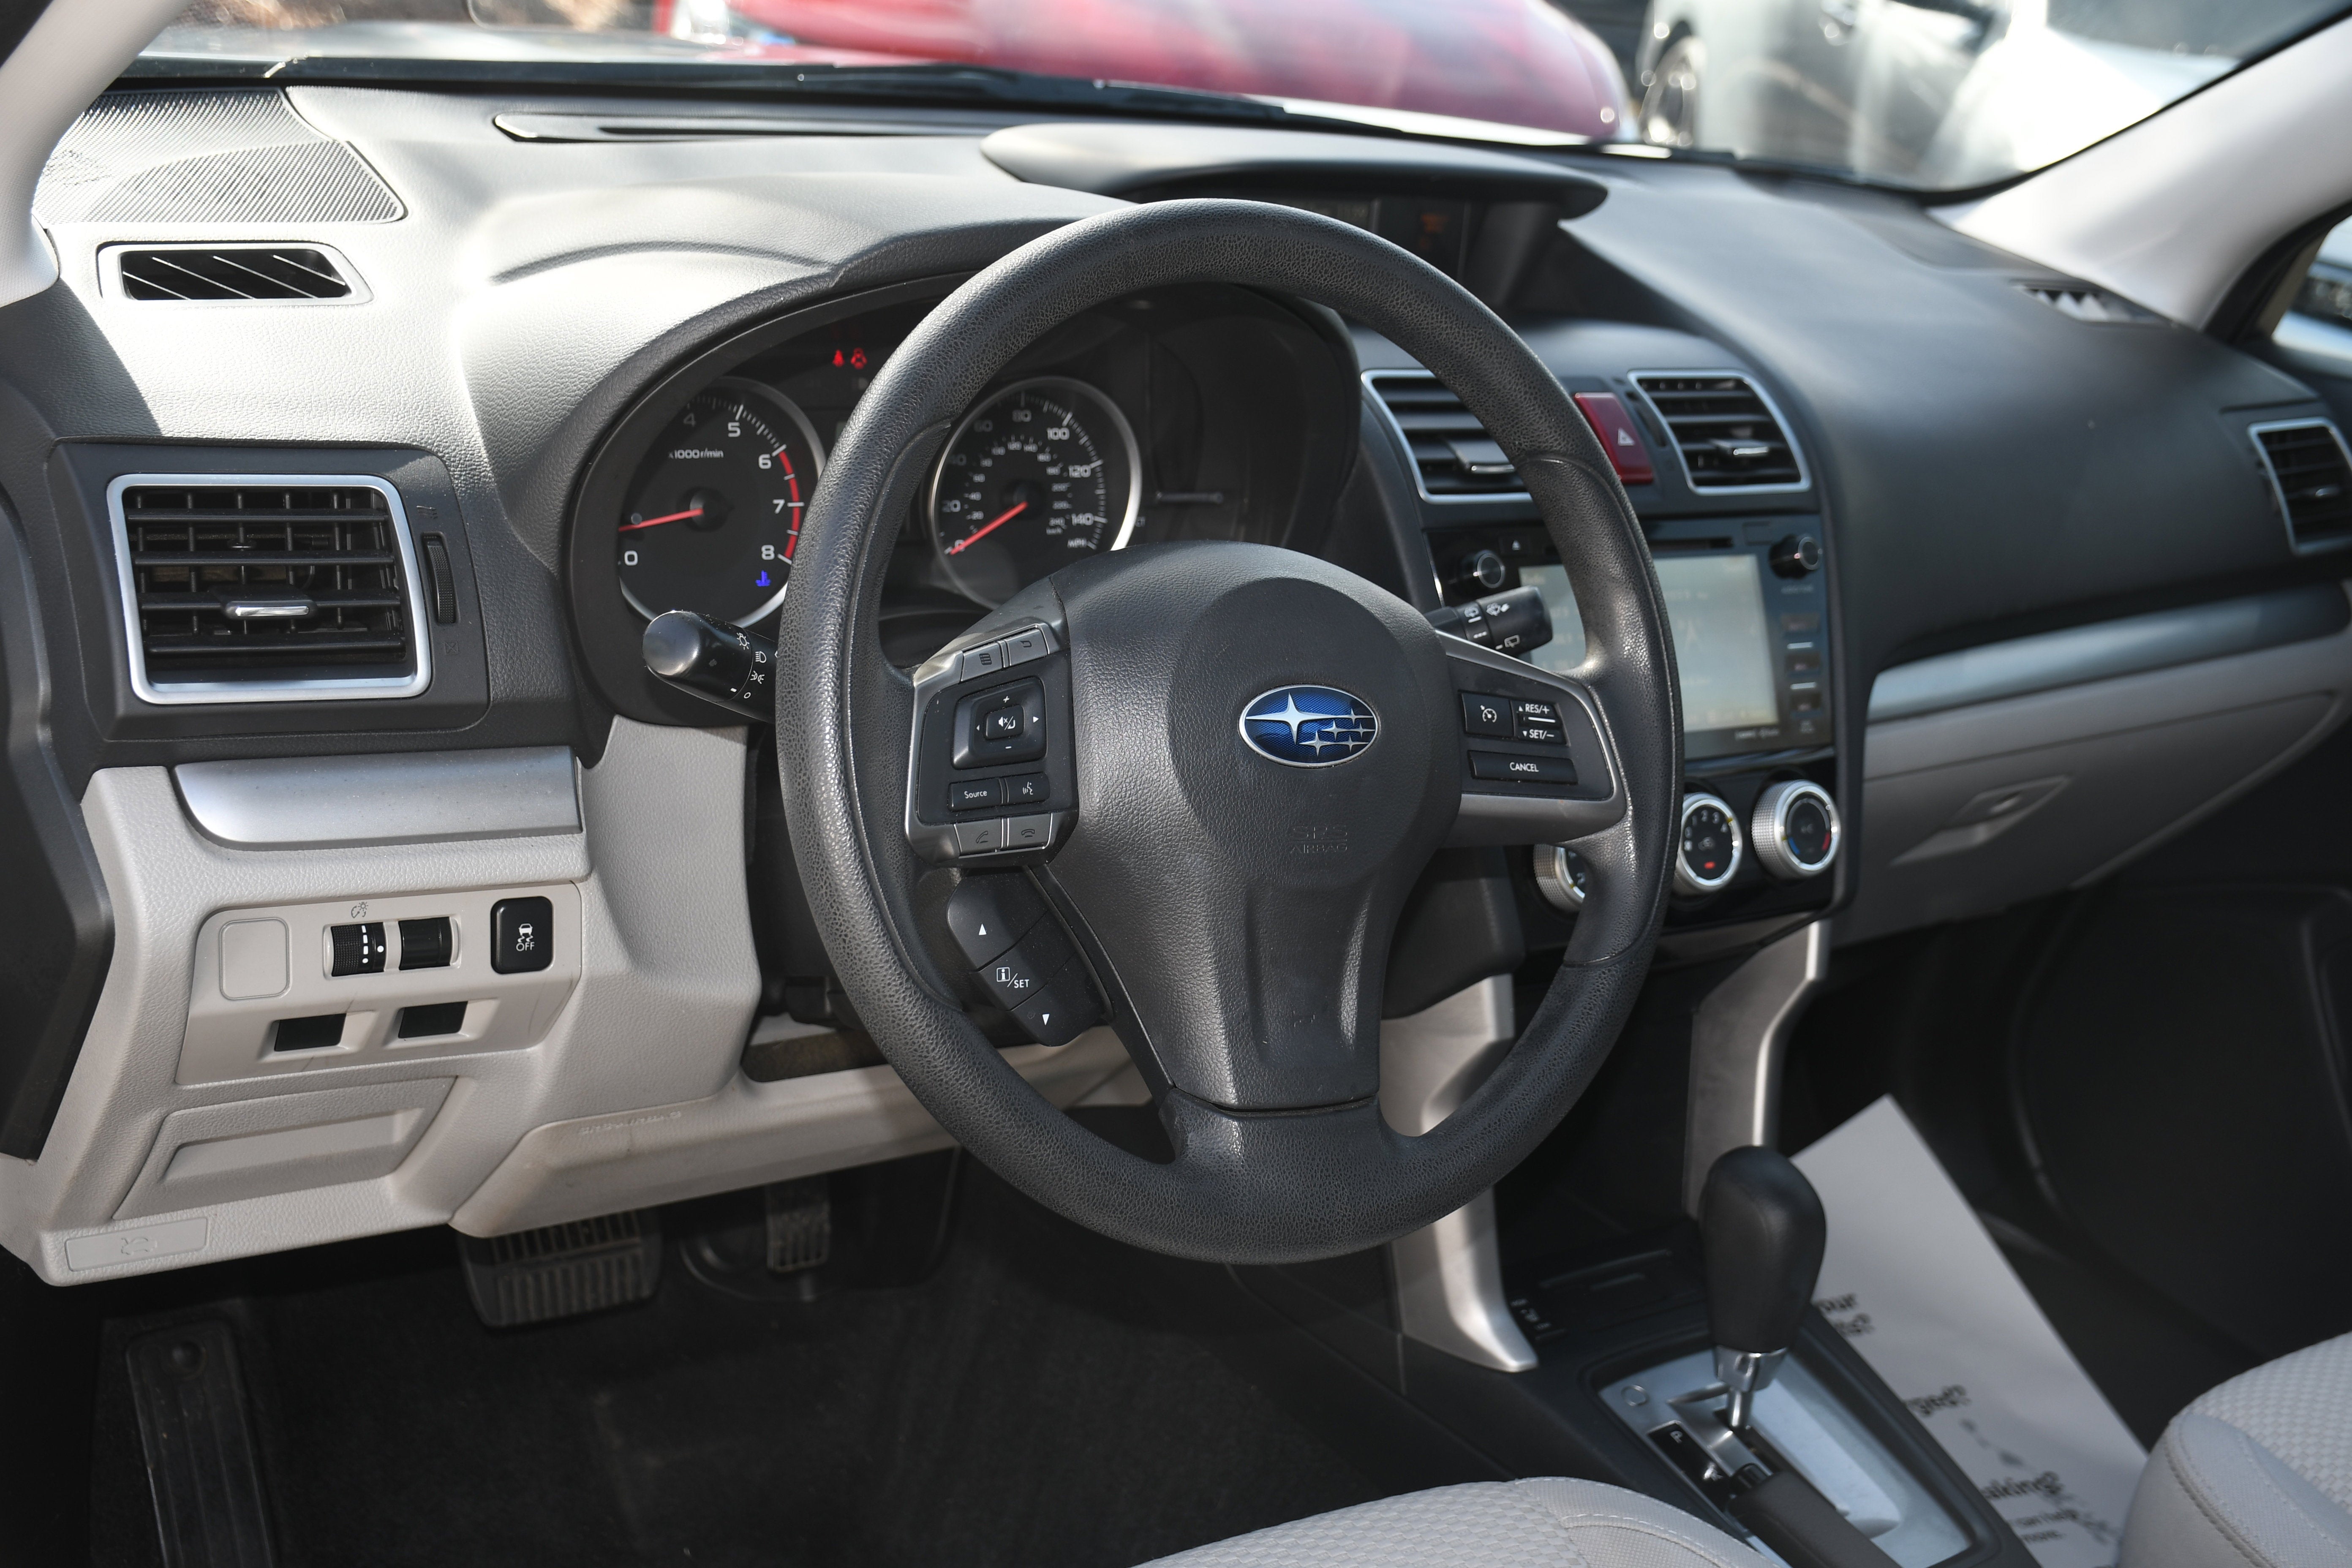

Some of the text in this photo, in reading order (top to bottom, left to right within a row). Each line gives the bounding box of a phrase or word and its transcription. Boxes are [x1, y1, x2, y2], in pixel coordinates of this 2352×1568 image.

[683, 413, 696, 427] 4
[727, 422, 741, 438] 5
[1046, 427, 1070, 441] 100
[758, 454, 772, 469] 6
[1068, 465, 1092, 478] 120
[772, 499, 785, 514] 7
[1071, 512, 1094, 526] 140
[624, 550, 639, 566] 0
[761, 544, 775, 560] 8
[1509, 762, 1539, 772] CANCEL
[964, 791, 987, 799] Source
[516, 942, 535, 951] OFF
[1670, 1430, 1683, 1444] P
